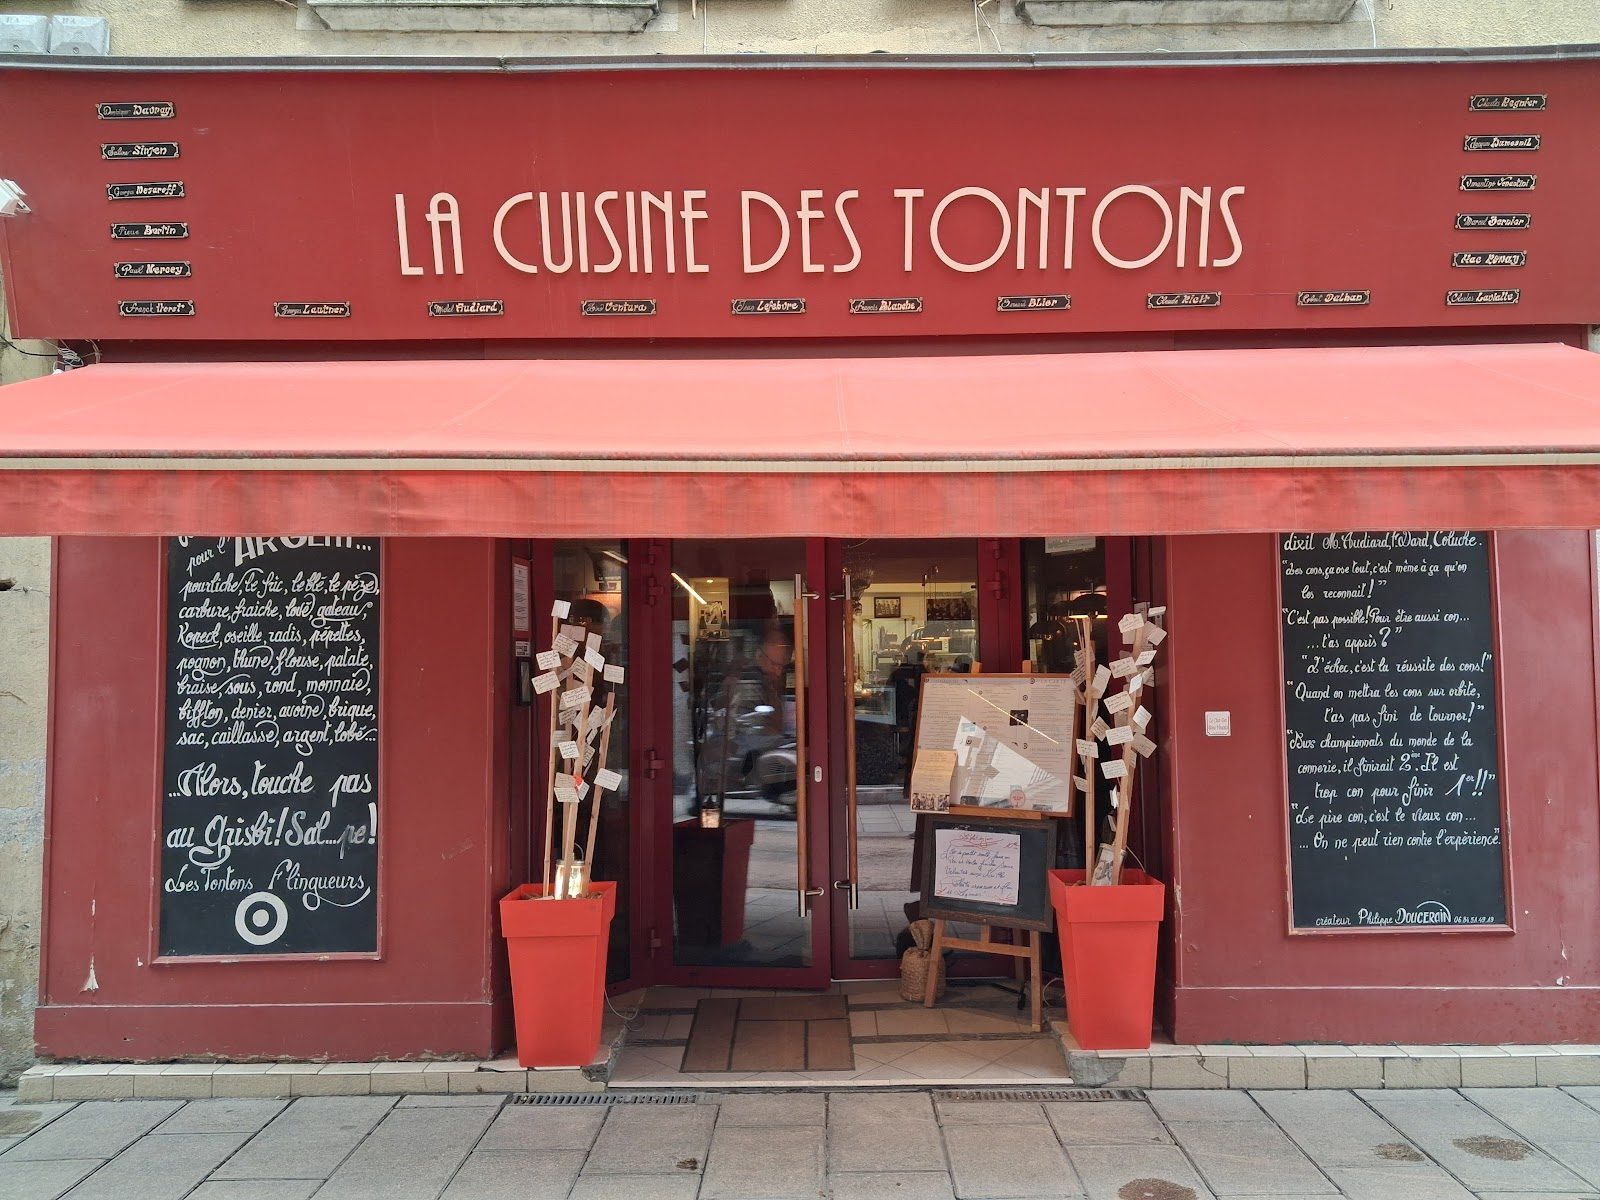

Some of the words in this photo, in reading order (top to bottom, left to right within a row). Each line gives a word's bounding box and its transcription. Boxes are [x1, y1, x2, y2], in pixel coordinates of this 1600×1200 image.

[395, 192, 464, 275] LA
[493, 190, 710, 274] CUISINE
[741, 189, 862, 273] DES
[894, 184, 1246, 273] TONTONS
[303, 305, 345, 314] Lautner
[456, 302, 498, 313] Audiard
[605, 302, 647, 312] Ventura
[186, 549, 214, 577] pour
[1395, 560, 1419, 574] même
[1428, 563, 1440, 577] ça
[179, 598, 231, 620] carbure,
[1312, 615, 1330, 630] pas
[1395, 608, 1413, 623] être
[1414, 609, 1441, 623] aussi
[177, 622, 223, 650] Kopeck,
[224, 622, 267, 645] oseille,
[269, 623, 308, 647] radis,
[176, 655, 231, 681] pognon,
[272, 647, 324, 675] flouse,
[1378, 656, 1390, 673] la
[1396, 655, 1436, 673] réussite
[1439, 656, 1456, 672] des
[176, 673, 223, 698] braise,
[306, 667, 371, 696] monnaie,
[1334, 690, 1344, 700] on
[1348, 682, 1381, 699] mettra
[1384, 683, 1399, 699] les
[1403, 687, 1423, 698] cons
[1428, 686, 1446, 698] sur
[1449, 680, 1481, 698] orbite,
[231, 698, 277, 722] denier,
[278, 693, 327, 722] avoine,
[328, 695, 377, 721] brique,
[1349, 713, 1371, 728] pas
[1372, 704, 1399, 728] fini
[1409, 705, 1422, 722] de
[211, 720, 280, 749] caillasse,
[1320, 732, 1384, 752] championnats
[1389, 732, 1403, 748] du
[1408, 732, 1438, 748] monde
[1443, 731, 1455, 747] de
[1460, 731, 1474, 747] la
[1343, 757, 1353, 773] il
[1353, 755, 1395, 777] finirait
[1443, 753, 1460, 771] est
[251, 759, 314, 796] touche
[328, 773, 372, 808] pas
[1315, 781, 1338, 804] trop
[1346, 786, 1364, 798] con
[1371, 785, 1400, 804] pour
[1402, 776, 1434, 807] finir
[1318, 808, 1343, 830] pire
[1395, 806, 1406, 823] le
[1411, 808, 1441, 822] vieux
[166, 826, 195, 849] au
[188, 806, 290, 867] Grisbi!
[1334, 838, 1348, 849] ne
[1352, 828, 1379, 853] peut
[1383, 832, 1404, 848] rien
[1406, 829, 1433, 847] contre
[200, 864, 254, 893] Tontons
[268, 858, 371, 911] Flingueurs
[1315, 913, 1352, 926] créateur
[1358, 908, 1393, 927] Philippe
